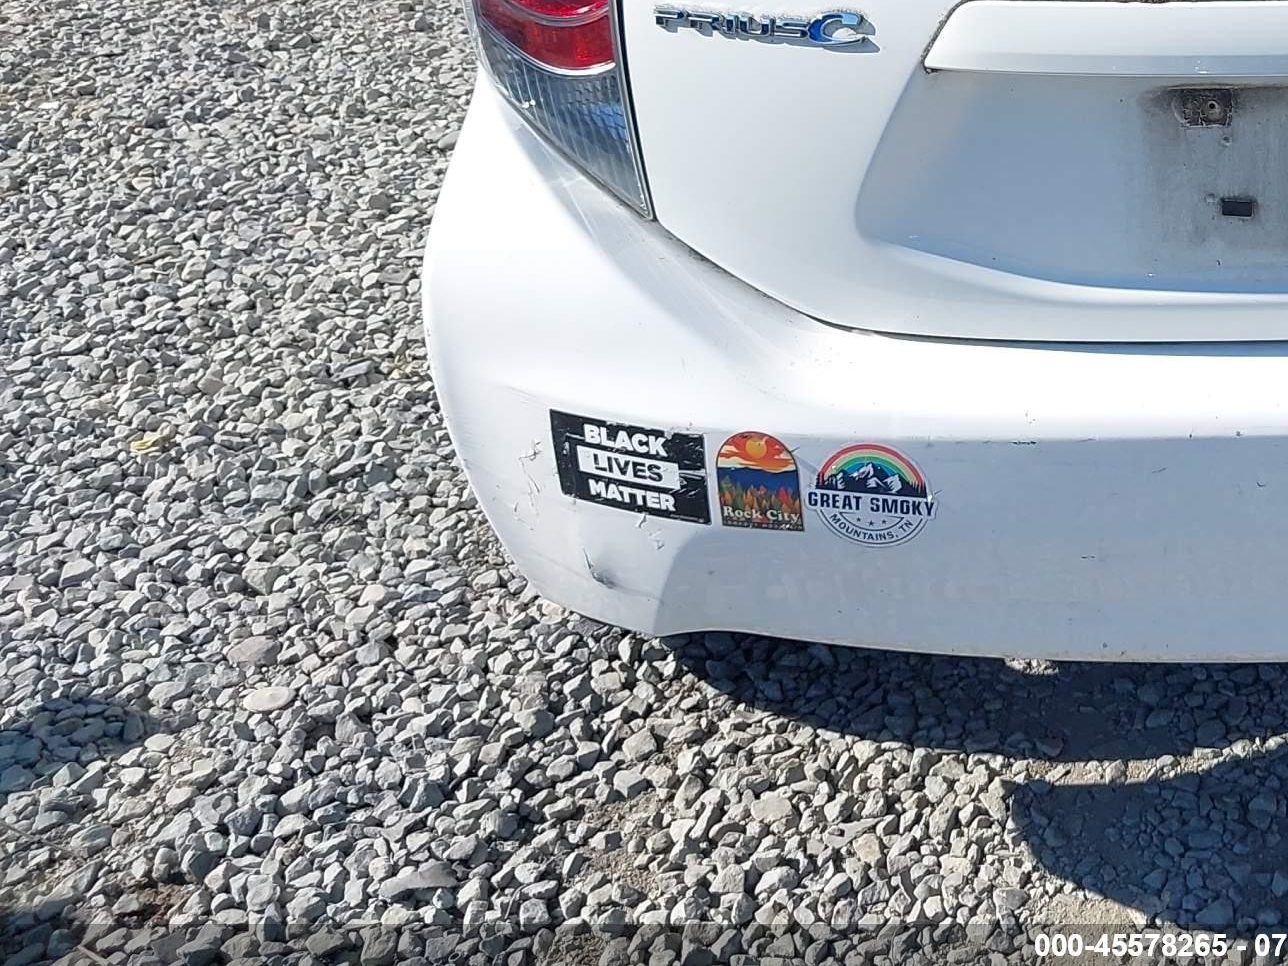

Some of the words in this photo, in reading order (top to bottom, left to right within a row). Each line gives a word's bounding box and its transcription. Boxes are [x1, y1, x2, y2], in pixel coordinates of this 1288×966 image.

[583, 423, 668, 457] BLACK
[592, 452, 664, 482] LIVES
[588, 478, 676, 512] MATTER
[808, 490, 863, 512] GREAT
[870, 498, 935, 517] SMOKY
[723, 505, 763, 519] Rock
[766, 509, 800, 523] City
[898, 520, 914, 536] TN
